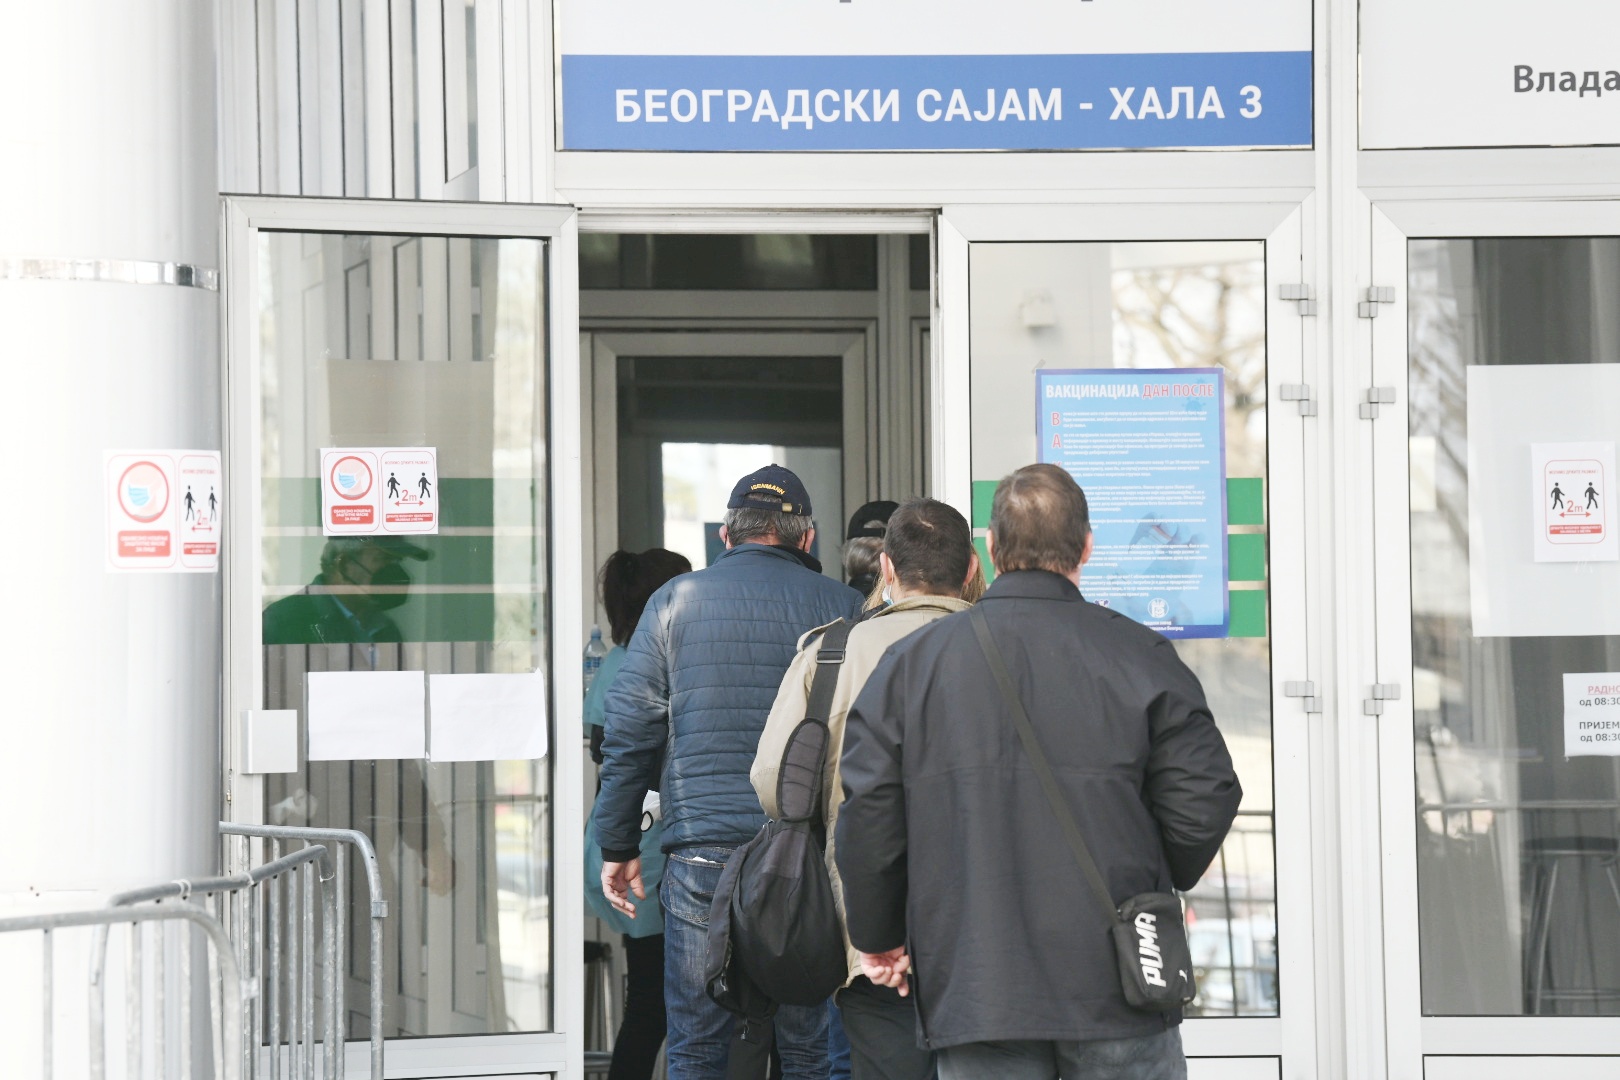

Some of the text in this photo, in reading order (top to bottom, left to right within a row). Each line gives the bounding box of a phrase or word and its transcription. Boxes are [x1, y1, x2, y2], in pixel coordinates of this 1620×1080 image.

[1514, 64, 1620, 97] Влада
[615, 85, 1263, 130] БЕОГРАДСКИ САЈАМ - ХАЛА 3
[1046, 383, 1214, 400] ВАКЦИНАЦИЈА ДАН ПОСЛЕ
[1134, 912, 1167, 987] PUMA
